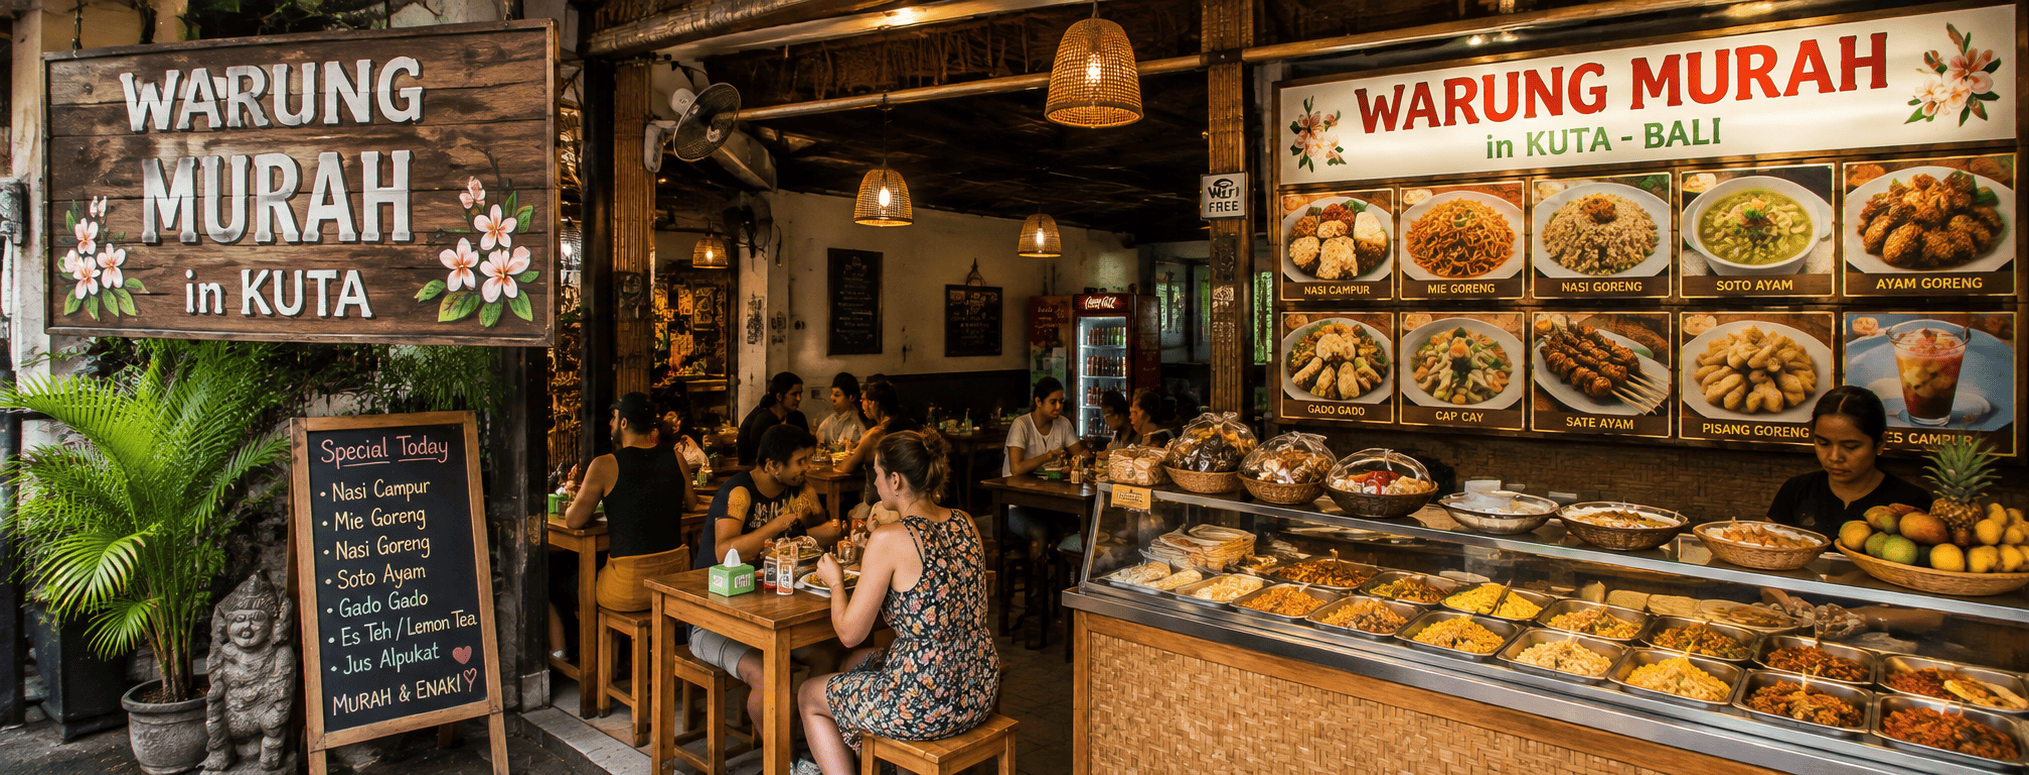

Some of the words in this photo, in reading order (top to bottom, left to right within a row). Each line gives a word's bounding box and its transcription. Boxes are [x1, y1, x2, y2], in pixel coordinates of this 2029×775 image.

[119, 56, 424, 132] WARUNG
[1354, 63, 1607, 133] WARUNG
[1630, 32, 1888, 110] MURAH
[1486, 134, 1513, 159] in
[1526, 126, 1612, 157] KUTA
[1643, 117, 1721, 149] BALI
[142, 150, 412, 244] MURAH
[1208, 201, 1239, 212] FREE
[185, 269, 224, 314] in
[241, 268, 374, 318] KUTA
[1303, 285, 1327, 295] NASI
[1329, 285, 1370, 295] CAMPUR
[1427, 284, 1447, 294] MIE
[1450, 283, 1495, 294] GORENG
[1561, 282, 1589, 292] NASI
[1591, 281, 1643, 292] GORENG
[1716, 280, 1752, 291] SOTO
[1755, 280, 1793, 291] AYAM
[1876, 278, 1916, 290] AYAM
[1920, 277, 1983, 289] GORENG
[1307, 404, 1335, 415] GADO
[1337, 405, 1365, 416] GADO
[1435, 411, 1459, 422] CAP
[1461, 412, 1484, 423] CAY
[1566, 416, 1596, 428] SATE
[1599, 417, 1634, 430] AYAM
[1702, 423, 1751, 435] PISANG
[1754, 425, 1809, 438] GORENG
[321, 436, 389, 469] Special
[396, 435, 448, 463] Today
[332, 481, 367, 502] Nasi
[373, 478, 430, 502] Campur
[335, 511, 364, 531] Mie
[371, 507, 426, 530] Goreng
[336, 540, 369, 560] Nasi
[377, 535, 430, 558] Goreng
[337, 569, 376, 589] Soto
[382, 563, 426, 588] Ayam
[339, 595, 381, 618] Gado
[388, 589, 428, 610] Gado
[341, 626, 361, 647] Es
[364, 621, 392, 642] Teh
[395, 617, 404, 641] /
[407, 616, 450, 636] Lemon
[451, 609, 478, 628] Tea
[343, 655, 372, 675] Jus
[380, 641, 440, 673] Alpukat
[333, 687, 392, 717] MURAH
[399, 683, 411, 702] &
